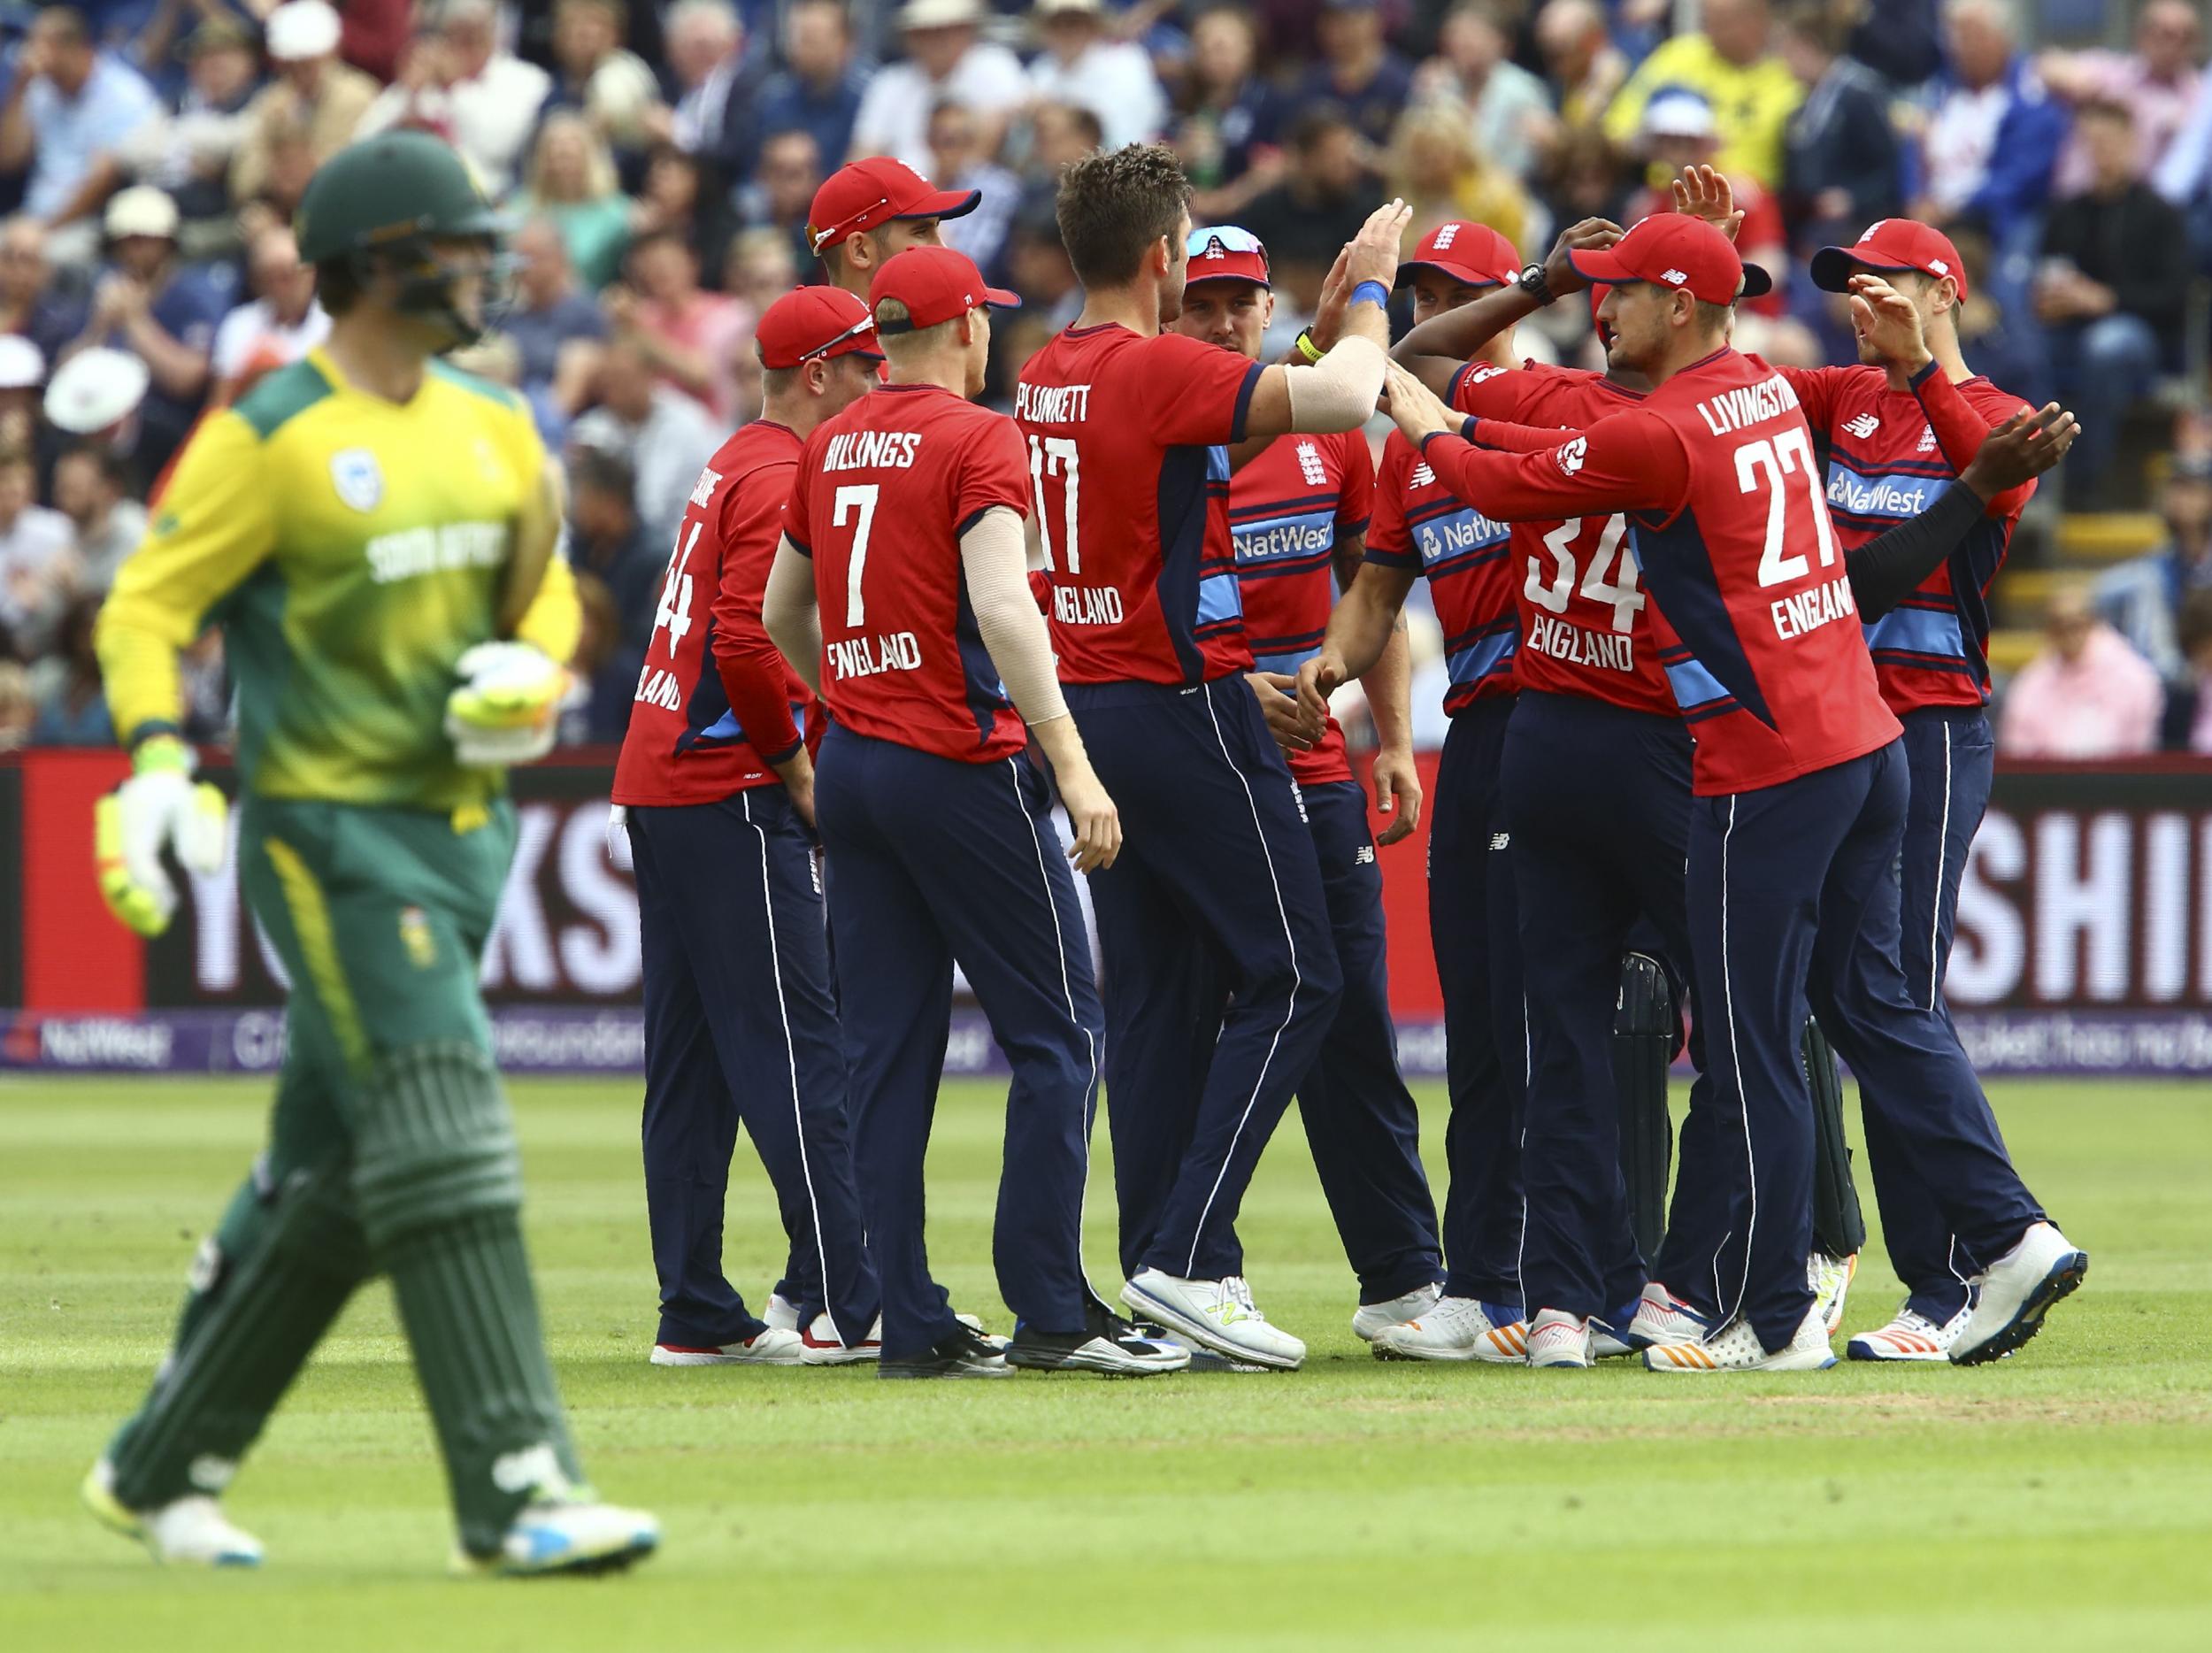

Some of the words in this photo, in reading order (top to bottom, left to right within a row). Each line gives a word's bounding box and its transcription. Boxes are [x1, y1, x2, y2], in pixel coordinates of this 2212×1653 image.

[1014, 381, 1091, 423] PLUNKETT
[823, 431, 922, 473] BILLINGS
[1028, 434, 1080, 574] 17
[1734, 426, 1835, 588] 27
[833, 484, 879, 628] 7
[1233, 520, 1333, 560] NatWest
[1524, 511, 1646, 634] 34
[1054, 584, 1123, 625] NGLAND
[1770, 574, 1854, 642] ENGLAN
[827, 631, 921, 680] ENGLAND
[1527, 612, 1633, 673] ENGLAND
[634, 665, 681, 711] LAND
[1944, 809, 2212, 1002] SHI
